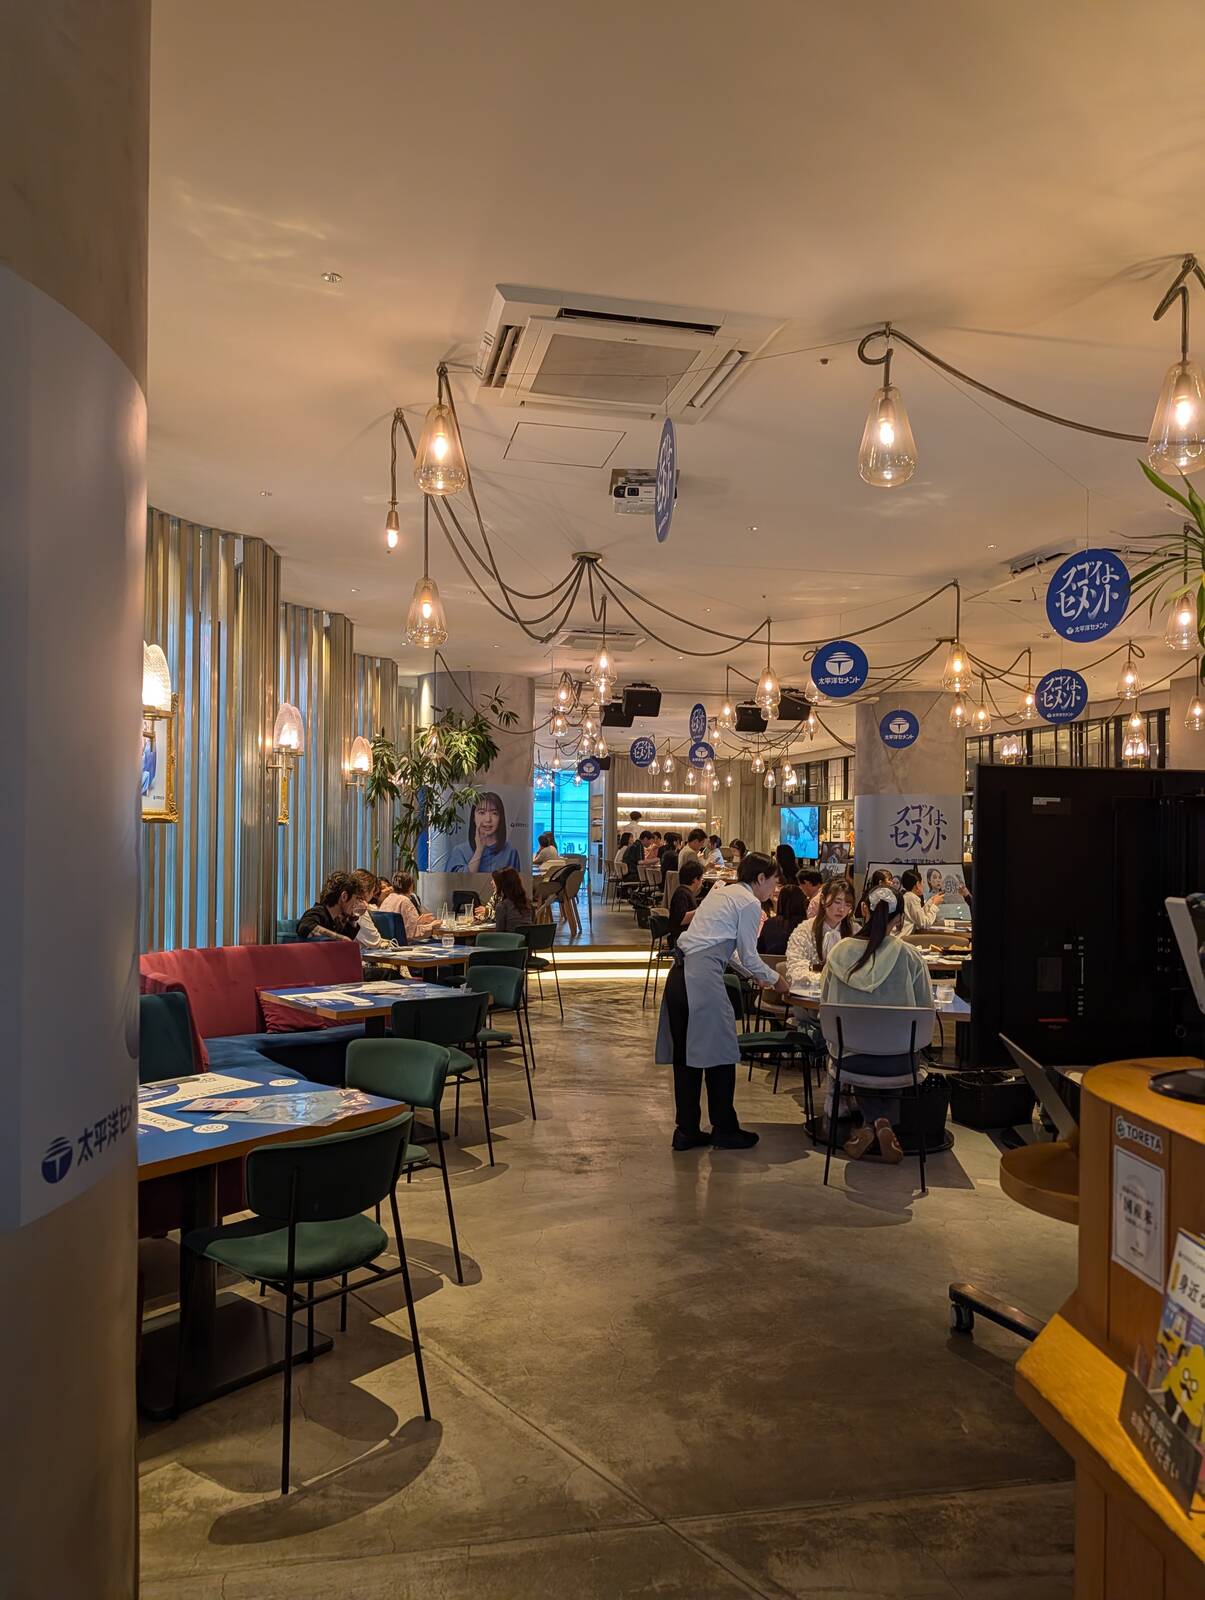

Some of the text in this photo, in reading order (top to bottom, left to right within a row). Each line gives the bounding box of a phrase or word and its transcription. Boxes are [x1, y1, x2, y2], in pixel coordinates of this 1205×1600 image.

[1056, 561, 1120, 593] スゴイよ
[1055, 582, 1119, 621] セメント
[1074, 622, 1109, 634] 太平洋セメント
[818, 676, 861, 685] 太平洋セメント
[1041, 675, 1082, 693] スゴイよ
[1040, 687, 1081, 711] セメント
[889, 804, 948, 827] スゴイよ
[889, 824, 947, 853] セメント
[1126, 1125, 1162, 1151] TORETA
